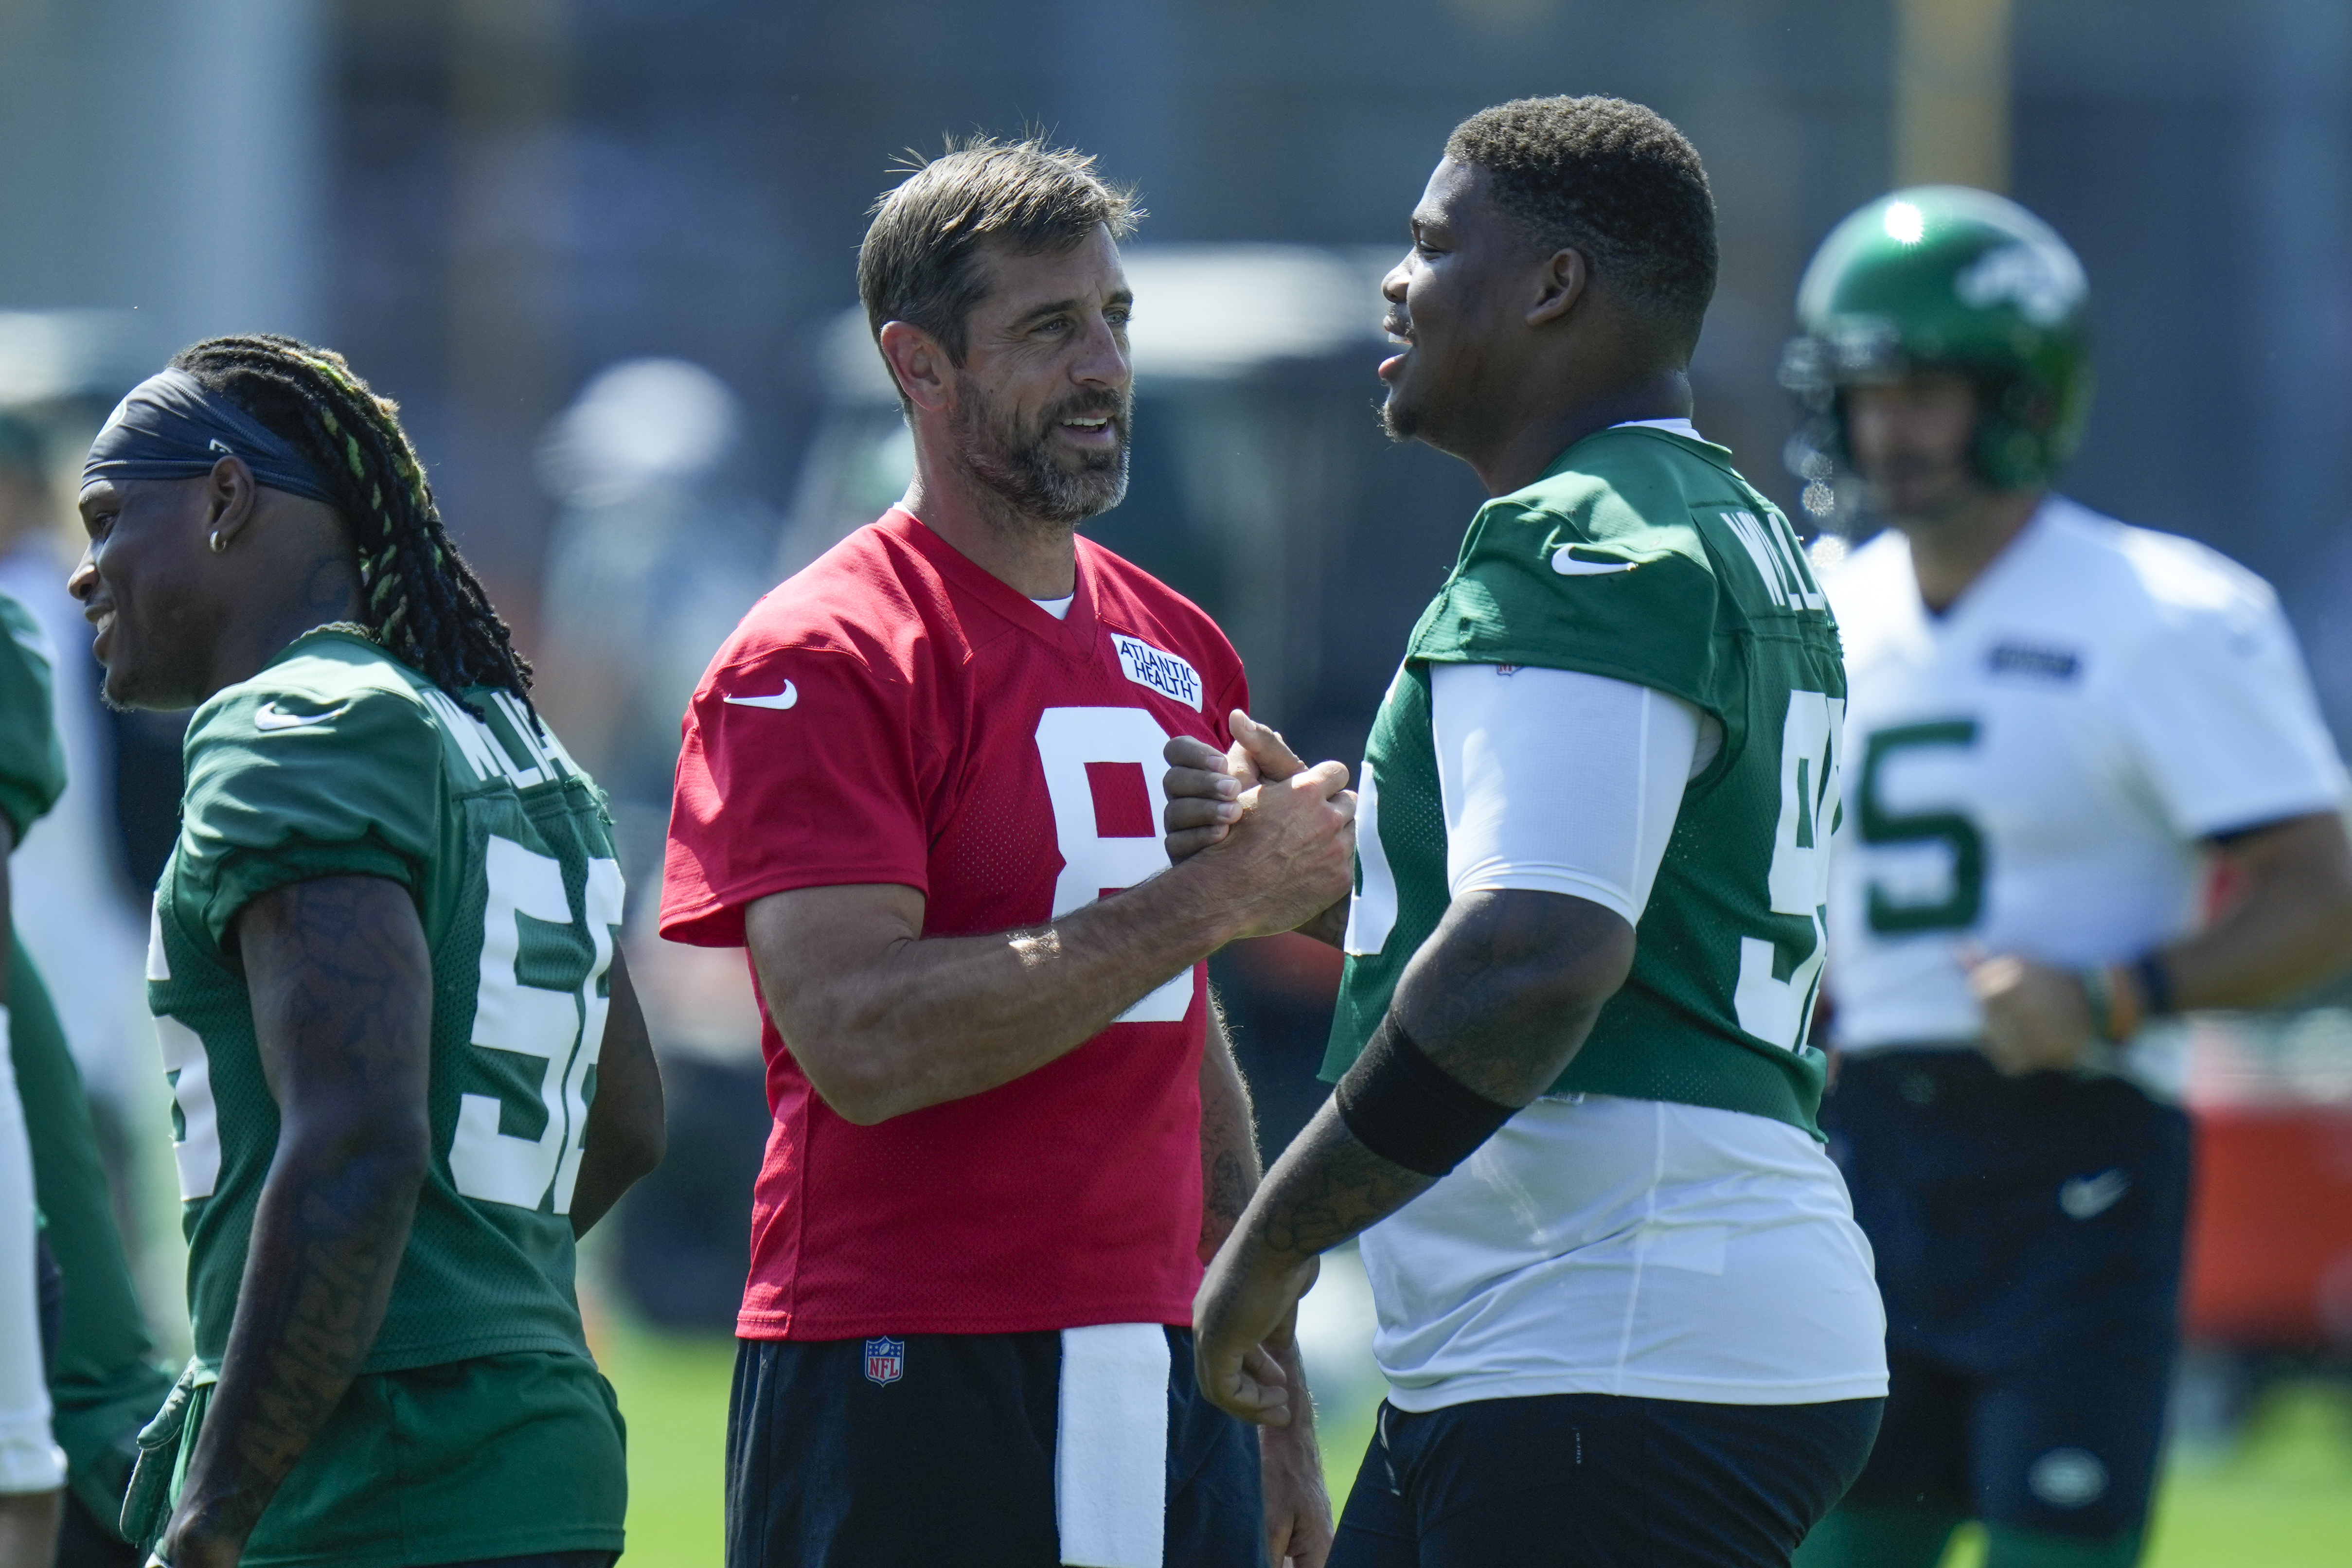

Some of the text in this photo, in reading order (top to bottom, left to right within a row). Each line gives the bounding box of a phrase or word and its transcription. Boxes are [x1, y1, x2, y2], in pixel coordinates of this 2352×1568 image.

[1120, 641, 1198, 686] ATLANTIC
[1134, 659, 1194, 702] HEALTH
[1859, 720, 1982, 932] 5
[1034, 706, 1194, 1022] 8
[869, 1357, 898, 1379] NFL
